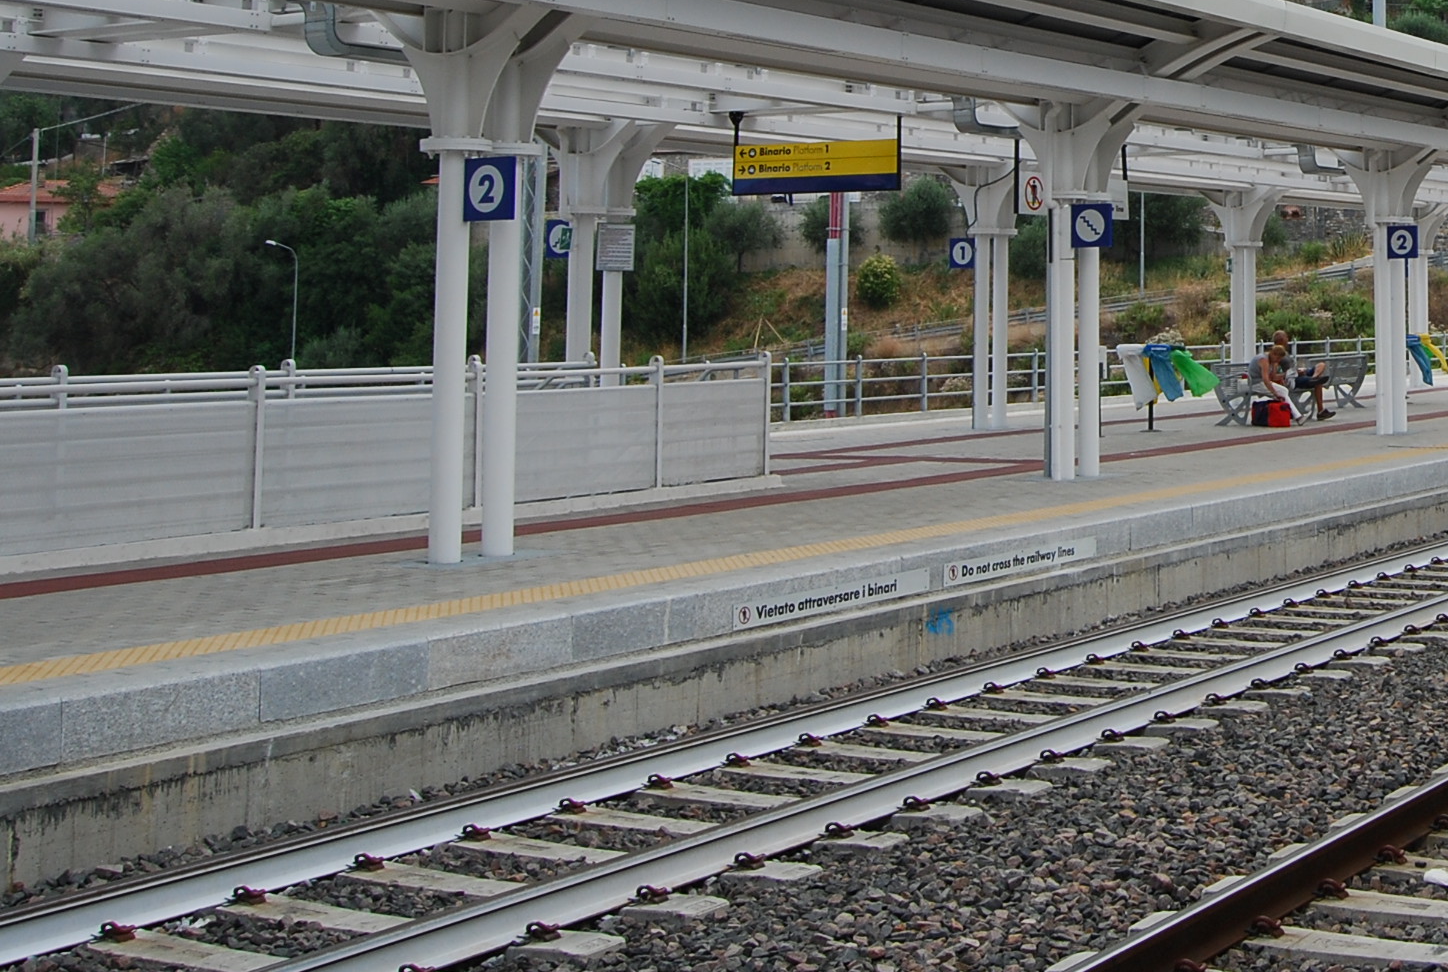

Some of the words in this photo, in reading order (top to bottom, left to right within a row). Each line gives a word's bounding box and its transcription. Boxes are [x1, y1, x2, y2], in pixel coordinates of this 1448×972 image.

[759, 147, 792, 157] Binario
[793, 145, 823, 155] Platform
[825, 144, 829, 153] 1
[758, 163, 791, 173] Binario
[792, 162, 823, 172] Platform
[824, 161, 831, 171] 2
[478, 174, 495, 204] 2
[1397, 234, 1407, 250] 2
[959, 246, 966, 260] 1
[961, 565, 975, 577] Do
[976, 563, 991, 575] not
[992, 560, 1012, 572] cross
[1012, 554, 1026, 567] the
[1026, 550, 1057, 563] railway
[1058, 546, 1075, 558] lines
[756, 602, 796, 619] Vietato
[798, 590, 860, 612] attraversare
[862, 585, 866, 598] i
[868, 579, 897, 597] binari
